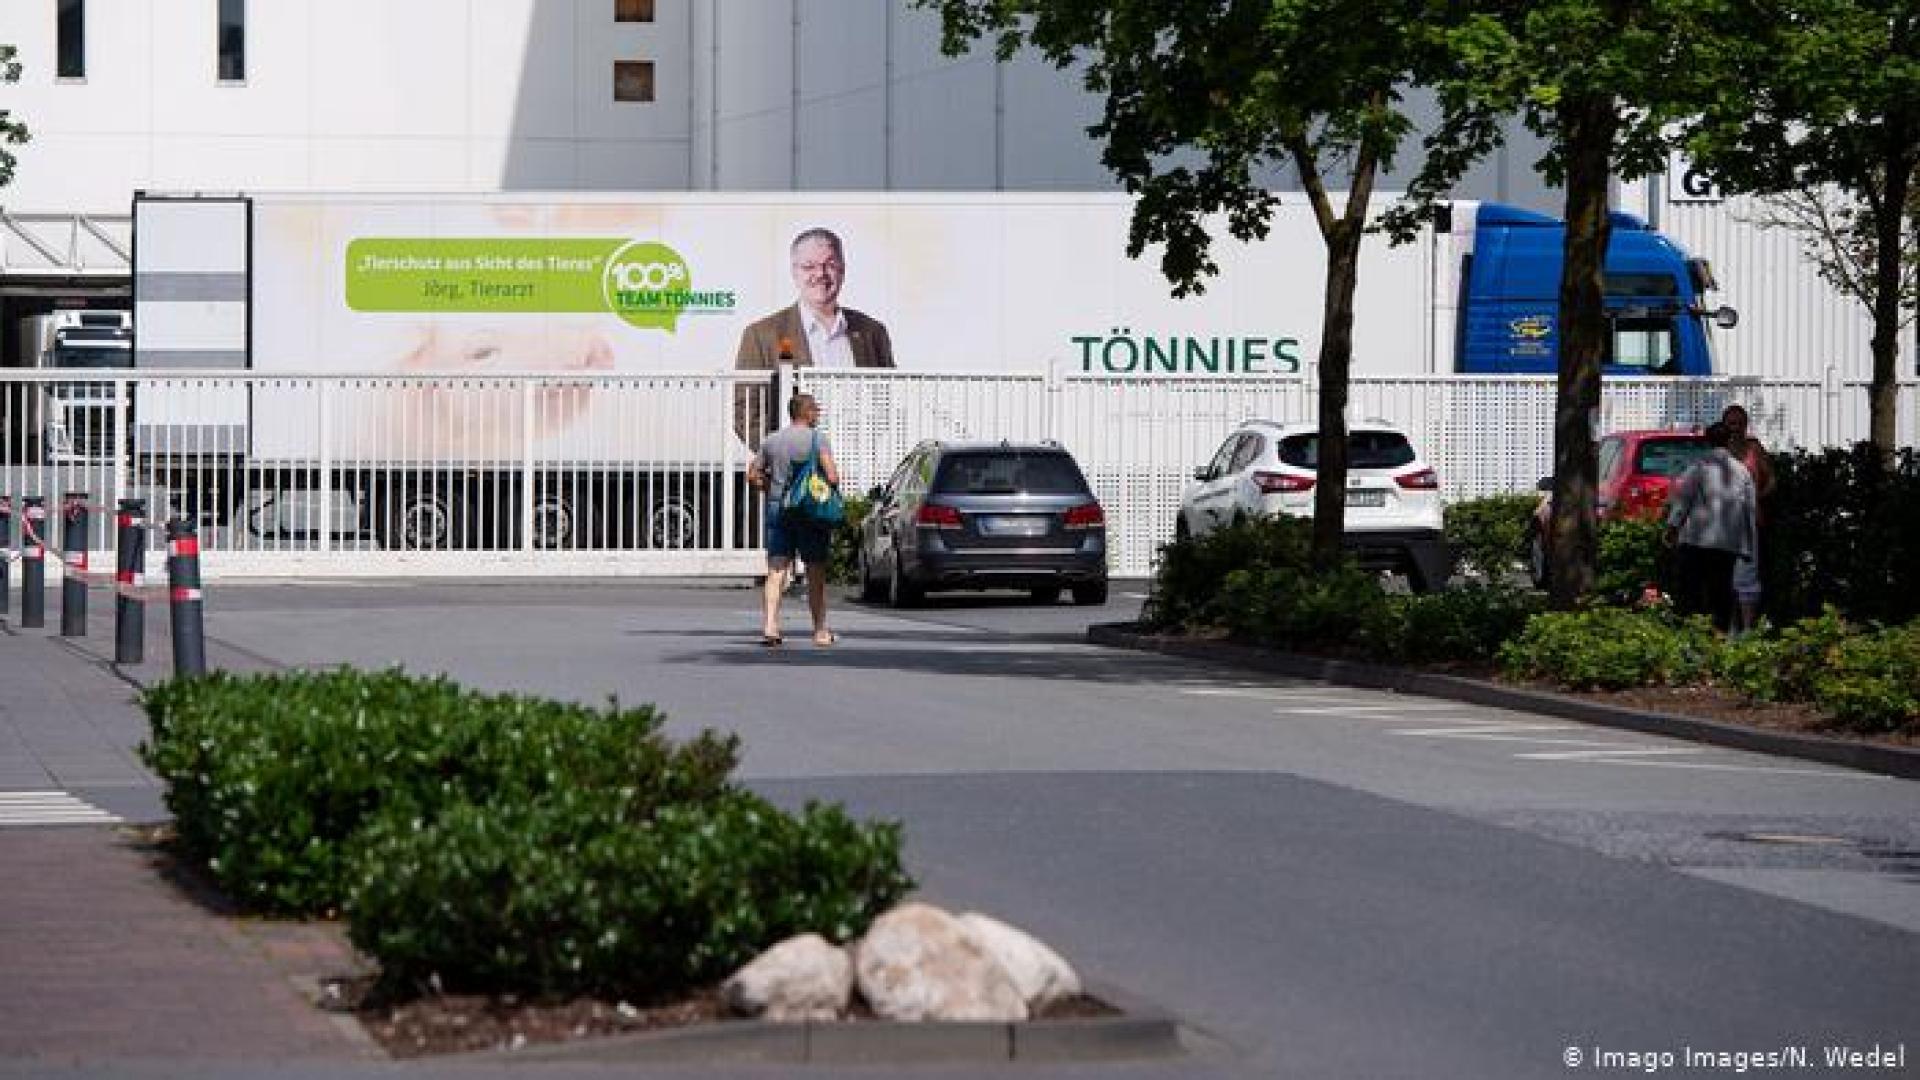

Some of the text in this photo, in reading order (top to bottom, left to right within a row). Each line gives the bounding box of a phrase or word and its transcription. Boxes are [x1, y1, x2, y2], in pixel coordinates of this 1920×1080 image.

[1682, 169, 1711, 196] G
[515, 254, 543, 271] des
[470, 280, 534, 298] Tierarzt
[616, 288, 736, 308] TEAM TÖNNIES
[1071, 328, 1300, 373] TÖNNIES
